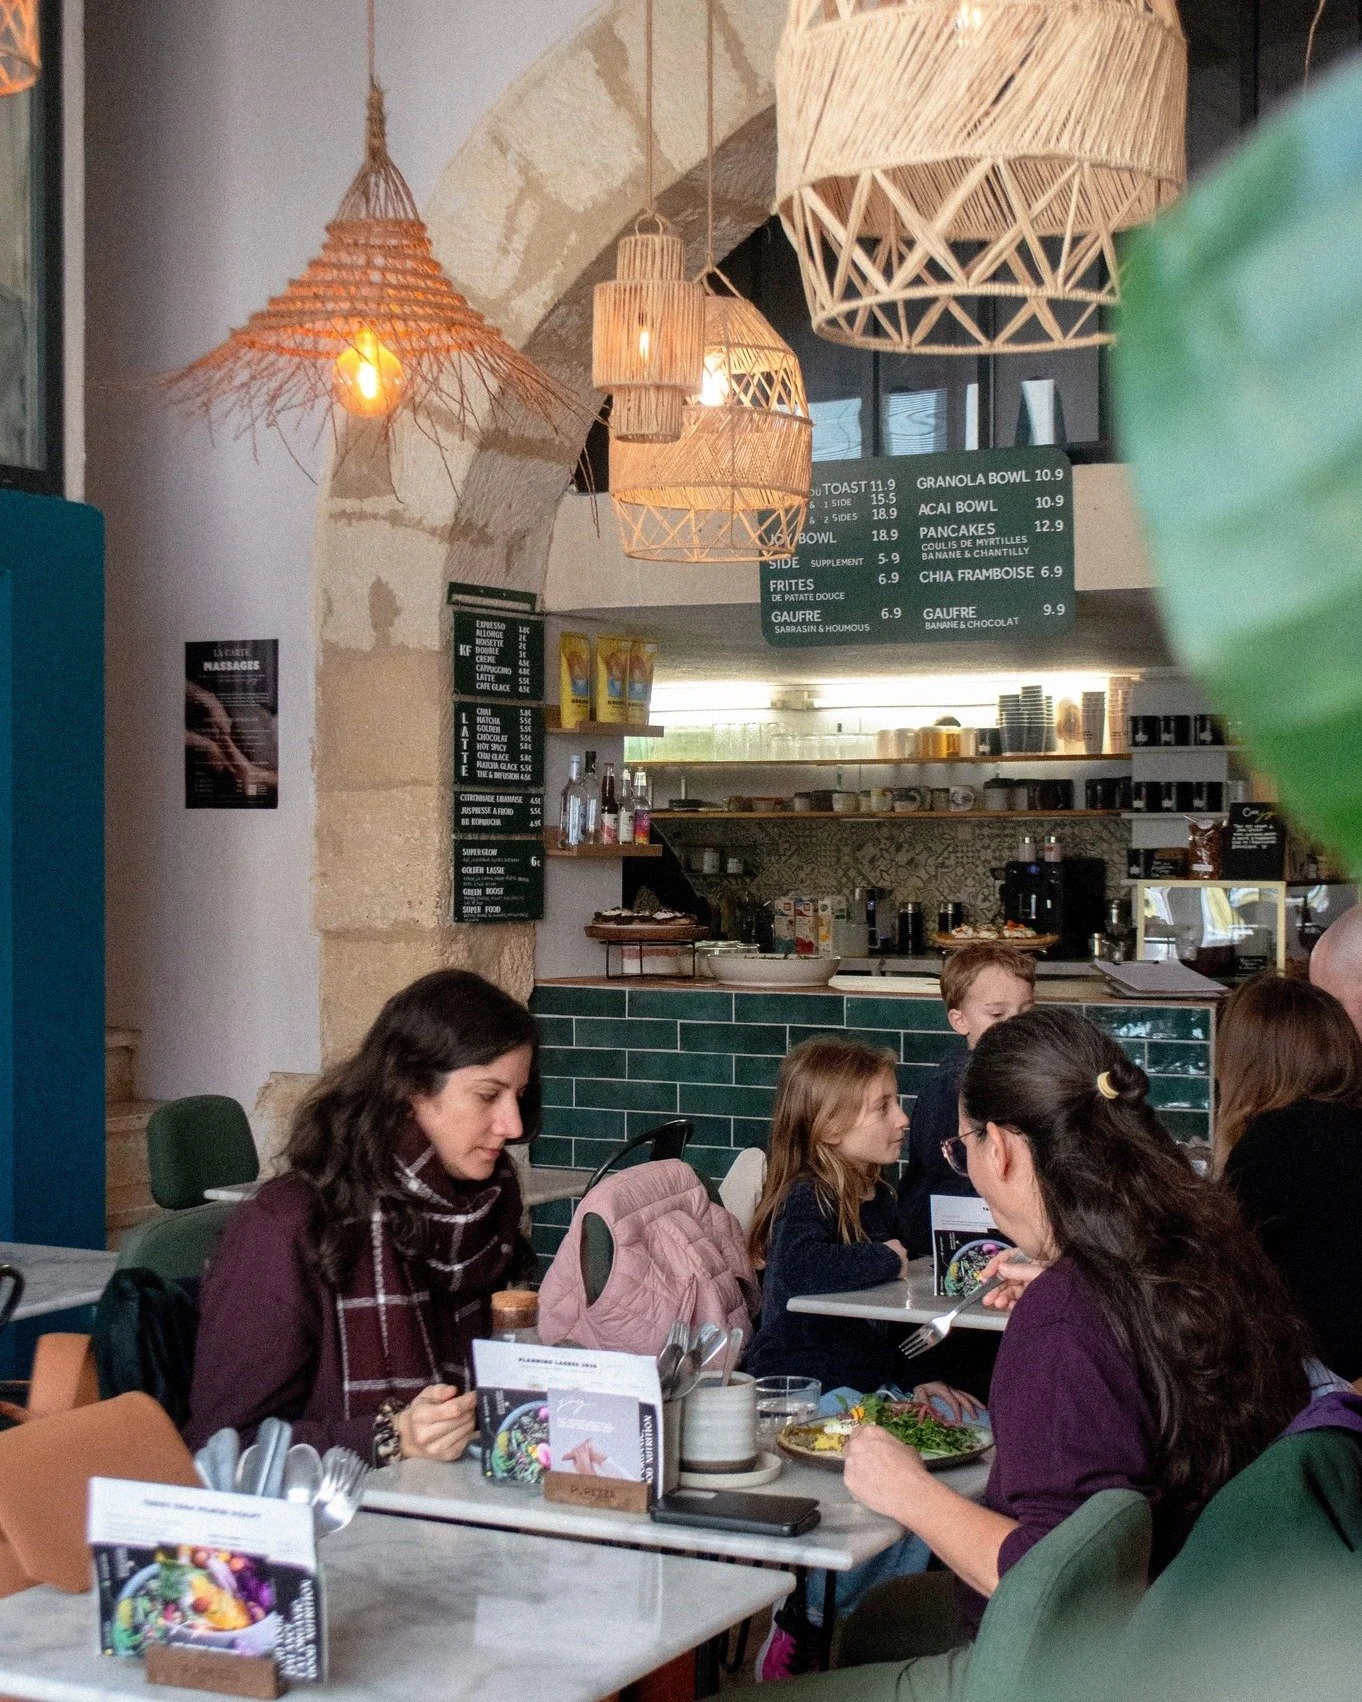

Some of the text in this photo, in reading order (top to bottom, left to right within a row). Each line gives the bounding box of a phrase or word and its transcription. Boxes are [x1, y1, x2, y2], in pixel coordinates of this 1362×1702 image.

[916, 470, 1030, 489] GRANOLA BOWL
[1034, 468, 1064, 482] 10.9
[822, 480, 868, 495] TOAST
[870, 478, 896, 492] 11.9
[824, 500, 828, 508] 1
[831, 498, 852, 508] SIDE
[870, 492, 896, 505] 15.5
[1035, 494, 1064, 508] 10.9
[872, 508, 898, 520] 18.9
[918, 500, 998, 516] ACAI BOWL
[824, 516, 829, 524] 2
[832, 512, 858, 522] SIDES
[920, 522, 996, 538] PANCAKES
[1034, 520, 1064, 532] 12.9
[800, 532, 837, 544] BOWL
[872, 530, 898, 542] 18.9
[921, 536, 1028, 552] COULIS DE MYRTILLES
[878, 552, 900, 564] 5.9
[922, 546, 1030, 560] BANANE & CHANTILLY
[769, 557, 864, 570] SIDE SUPPLEMENT
[878, 572, 900, 584] 6.9
[919, 566, 1035, 583] CHIA FRAMBOISE
[1040, 566, 1063, 578] 6.9
[770, 579, 814, 592] FRITES
[772, 592, 846, 602] DE PATATE DOUCE
[881, 608, 902, 620] 6.9
[923, 606, 976, 620] GAUFRE
[1043, 604, 1066, 616] 9.9
[771, 610, 822, 623] GAUFRE
[774, 624, 870, 634] SARRASIN & HOUMOUS
[925, 617, 1019, 630] BANANE & CHOCOLAT
[476, 638, 504, 648] NOISETTE
[460, 644, 472, 656] KF
[476, 646, 500, 656] DOUBLE
[204, 660, 260, 672] MASSAGES
[476, 664, 512, 676] CAPPUCCINO
[476, 673, 496, 682] LATTE
[476, 716, 500, 725] MATCHA
[476, 724, 500, 734] GOLDEN
[476, 734, 508, 742] CHOCOLAT
[476, 742, 507, 752] HOT SPICY
[494, 772, 520, 780] INFUSION
[471, 818, 502, 826] KOMBUCHA
[462, 848, 498, 856] SUPER GLOW
[462, 866, 506, 874] GOLDEN LASSIE
[462, 888, 482, 896] GREEN
[462, 906, 501, 914] SUPER FOOD
